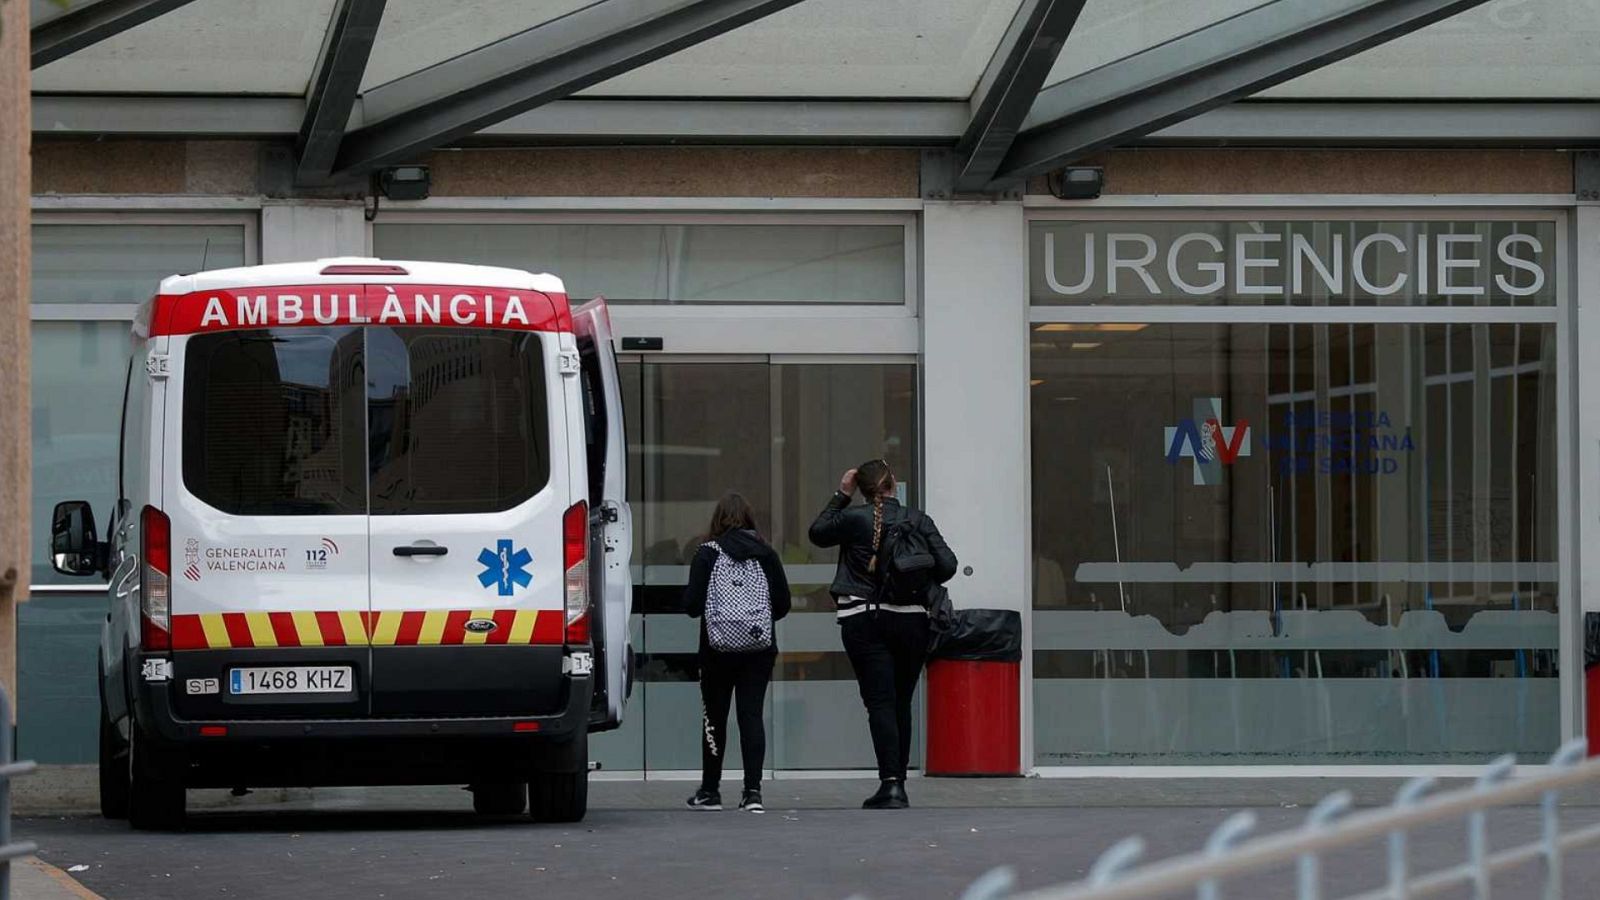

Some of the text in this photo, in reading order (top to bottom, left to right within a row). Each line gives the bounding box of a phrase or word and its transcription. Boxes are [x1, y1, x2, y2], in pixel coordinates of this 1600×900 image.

[1044, 222, 1546, 296] URGÈNCIES
[200, 285, 530, 328] AMBULÀNCIA
[205, 547, 288, 559] GENERALITAT
[306, 549, 327, 561] 112
[206, 560, 287, 571] VALENCIANA
[189, 679, 216, 693] SP
[249, 669, 345, 690] 1468 KHZ
